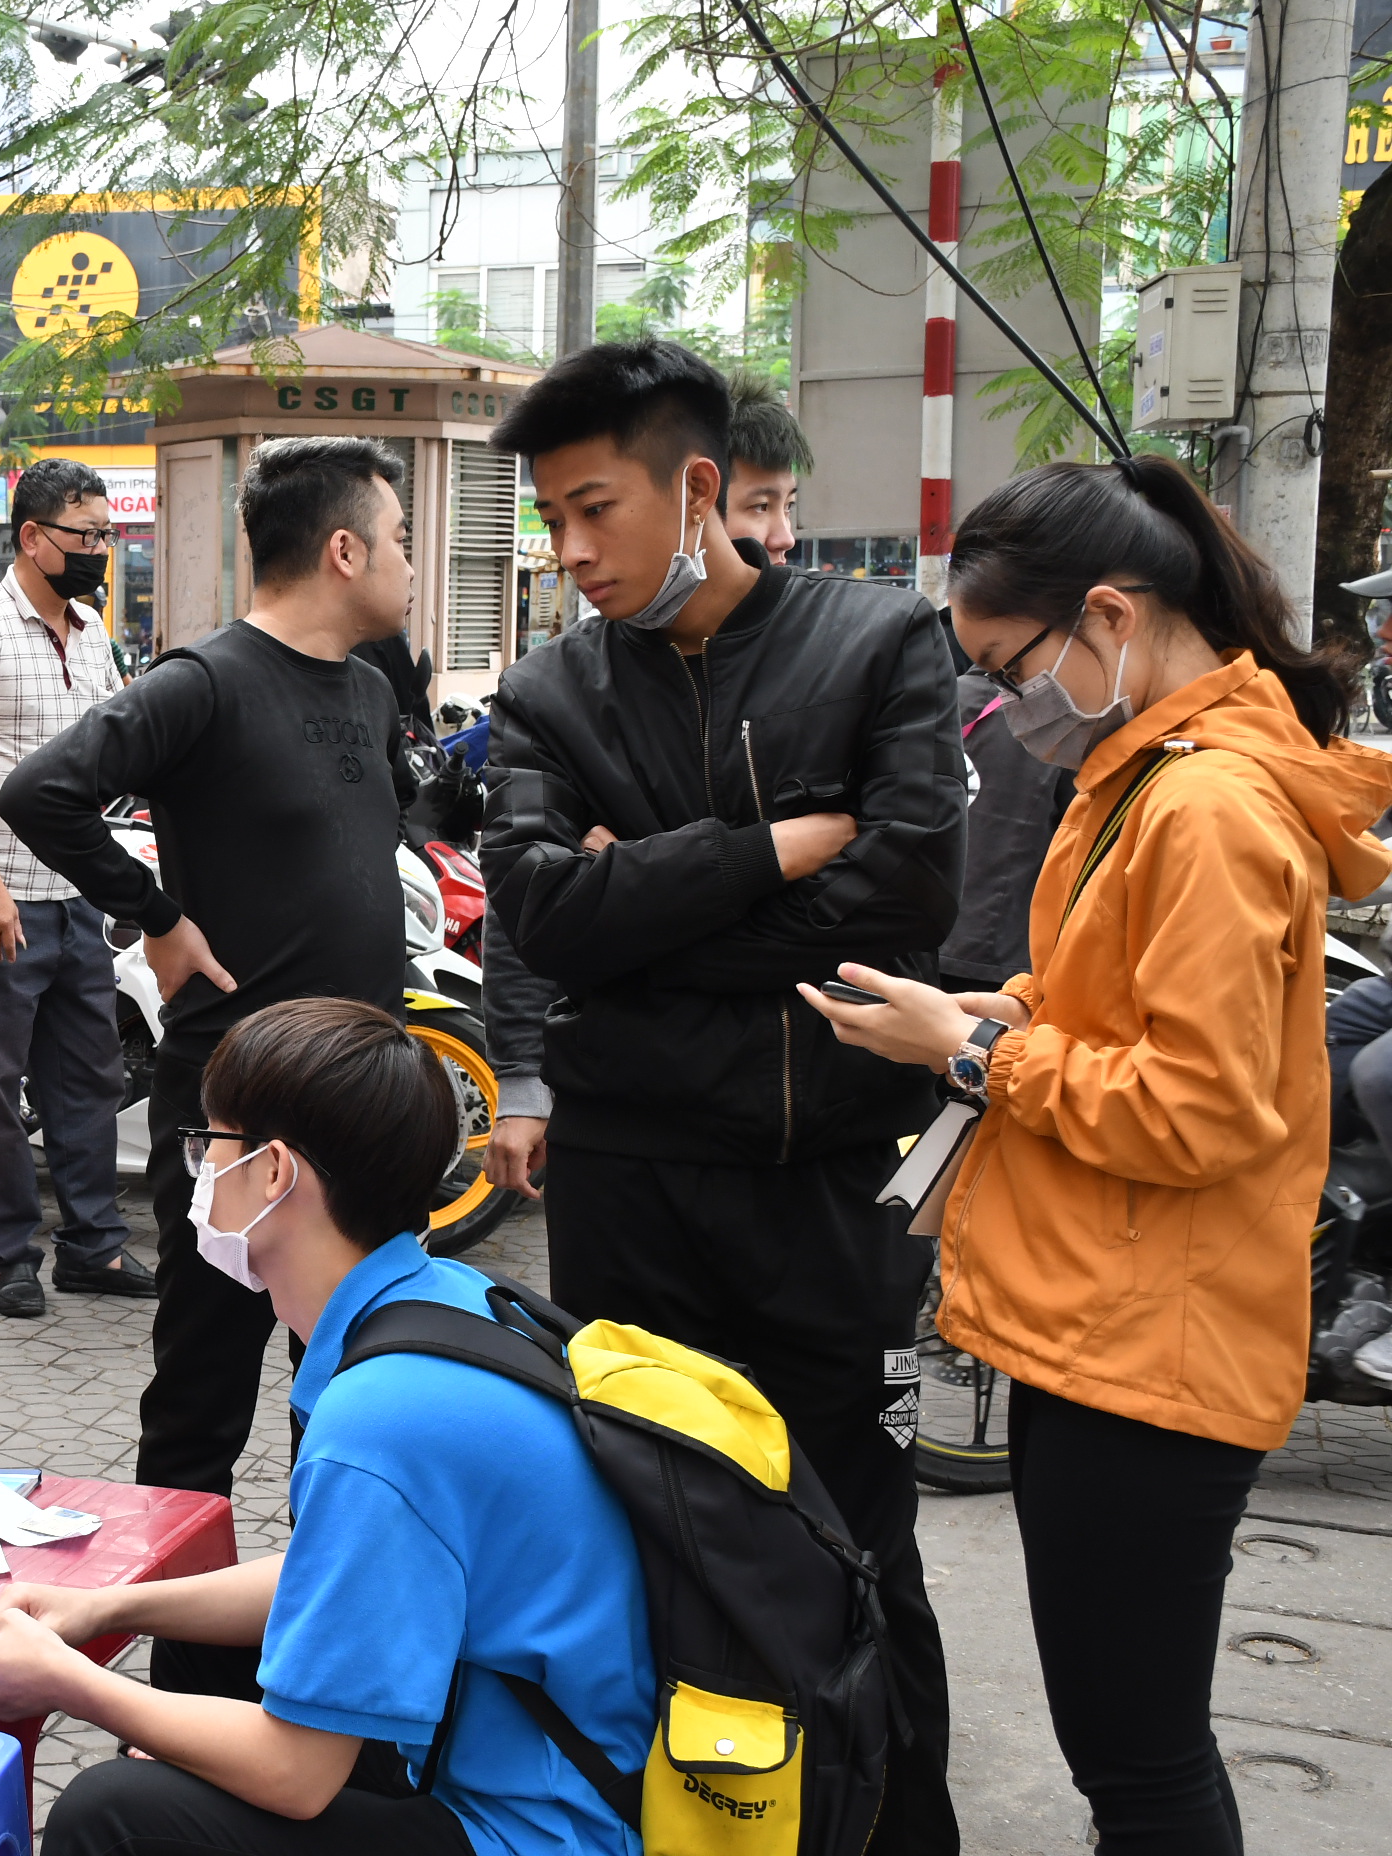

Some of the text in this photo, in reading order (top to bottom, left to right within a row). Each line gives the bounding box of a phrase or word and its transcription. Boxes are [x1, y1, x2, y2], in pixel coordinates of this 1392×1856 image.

[277, 386, 410, 412] CSGT
[878, 1411, 909, 1426] FASHION
[683, 1773, 768, 1820] DEGREY
